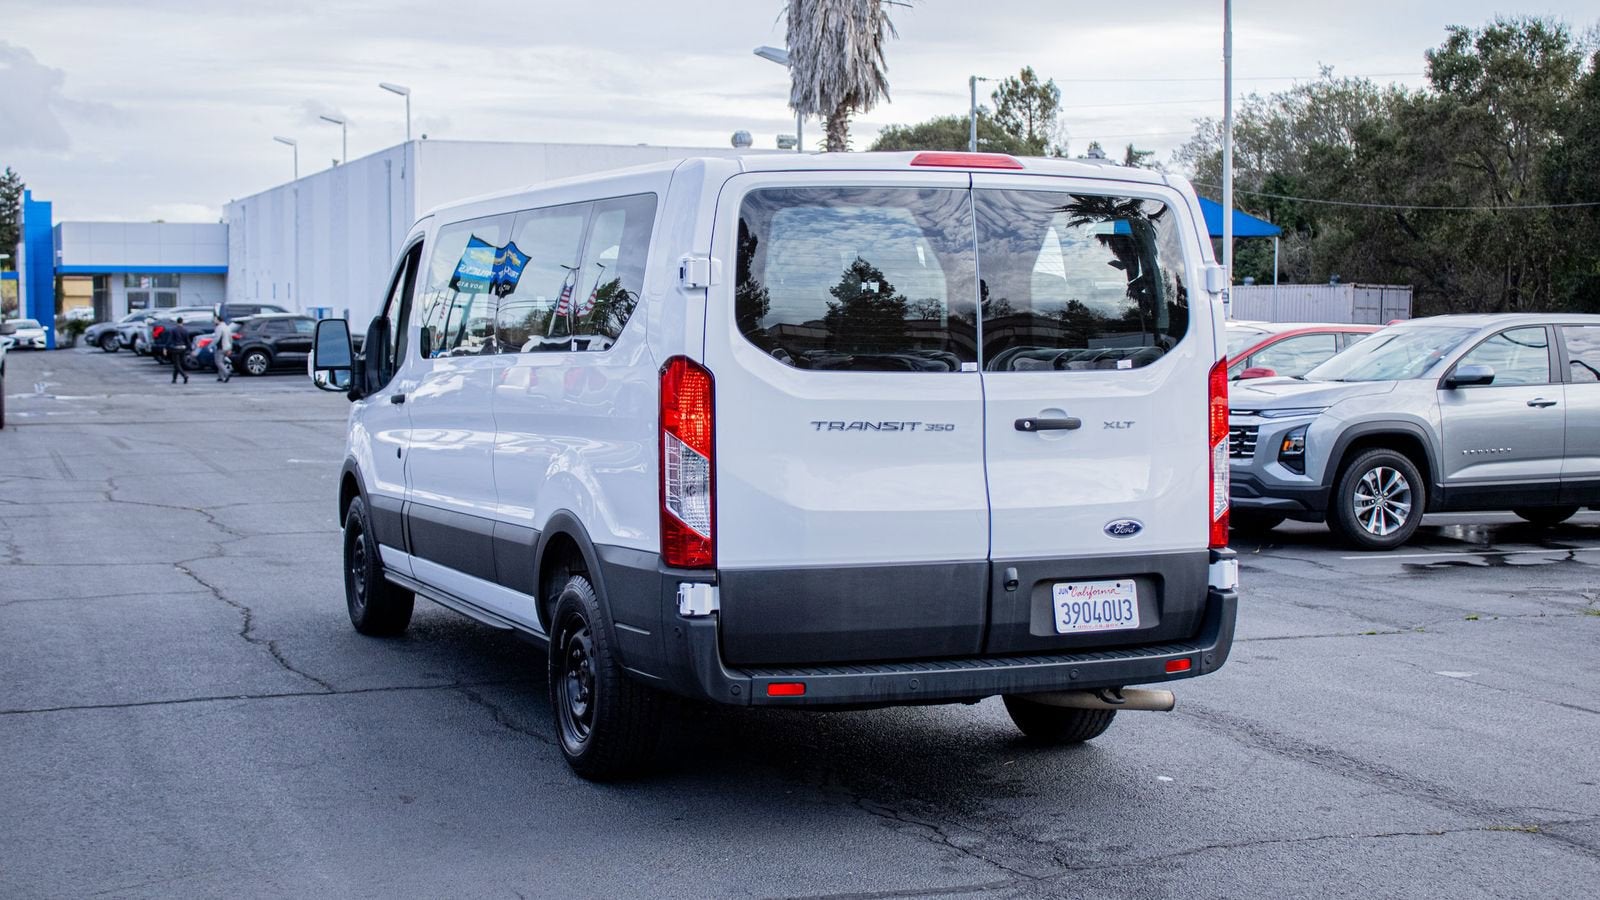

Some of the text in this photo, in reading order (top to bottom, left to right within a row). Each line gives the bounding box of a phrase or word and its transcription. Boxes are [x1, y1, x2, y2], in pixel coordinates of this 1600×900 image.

[810, 420, 956, 432] TRANSIT 350
[1103, 420, 1136, 430] XLT
[1071, 585, 1120, 599] California
[1061, 599, 1133, 625] 39040U3
